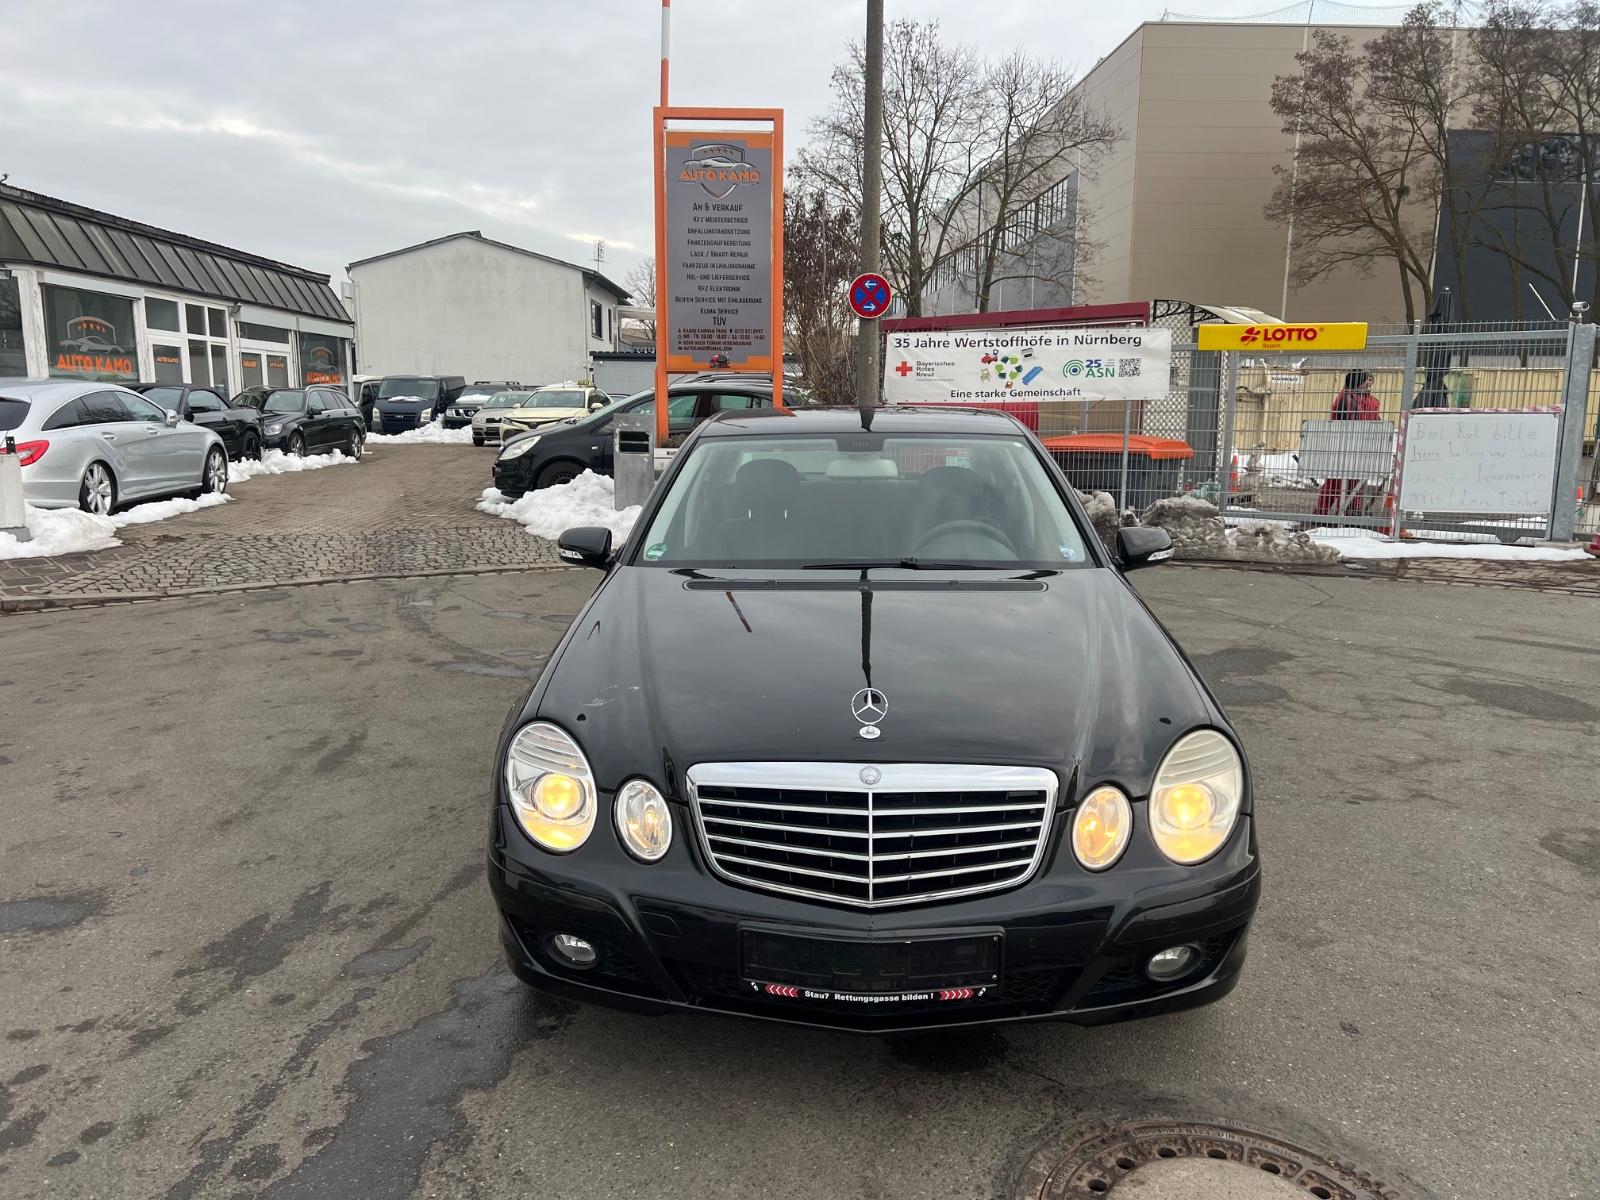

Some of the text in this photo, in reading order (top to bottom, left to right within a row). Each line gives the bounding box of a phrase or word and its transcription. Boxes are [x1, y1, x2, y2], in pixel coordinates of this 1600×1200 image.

[681, 169, 760, 181] AUTO KAMO
[693, 203, 702, 211] AN
[713, 315, 727, 326] TÜV
[1264, 327, 1317, 341] LOTTO
[894, 335, 1142, 348] 35 Jahre Wertstoffhöfe in Nürnberg
[56, 353, 132, 375] AUTO KAMO
[1085, 359, 1101, 368] 25
[1085, 368, 1115, 378] ASN
[951, 388, 1081, 398] Eine starke Gemeinschaft
[1412, 422, 1537, 440] Bei Rot bitte
[804, 991, 830, 1000] Stau?
[834, 993, 899, 1003] Rettungsgasse
[901, 993, 929, 1001] bilden
